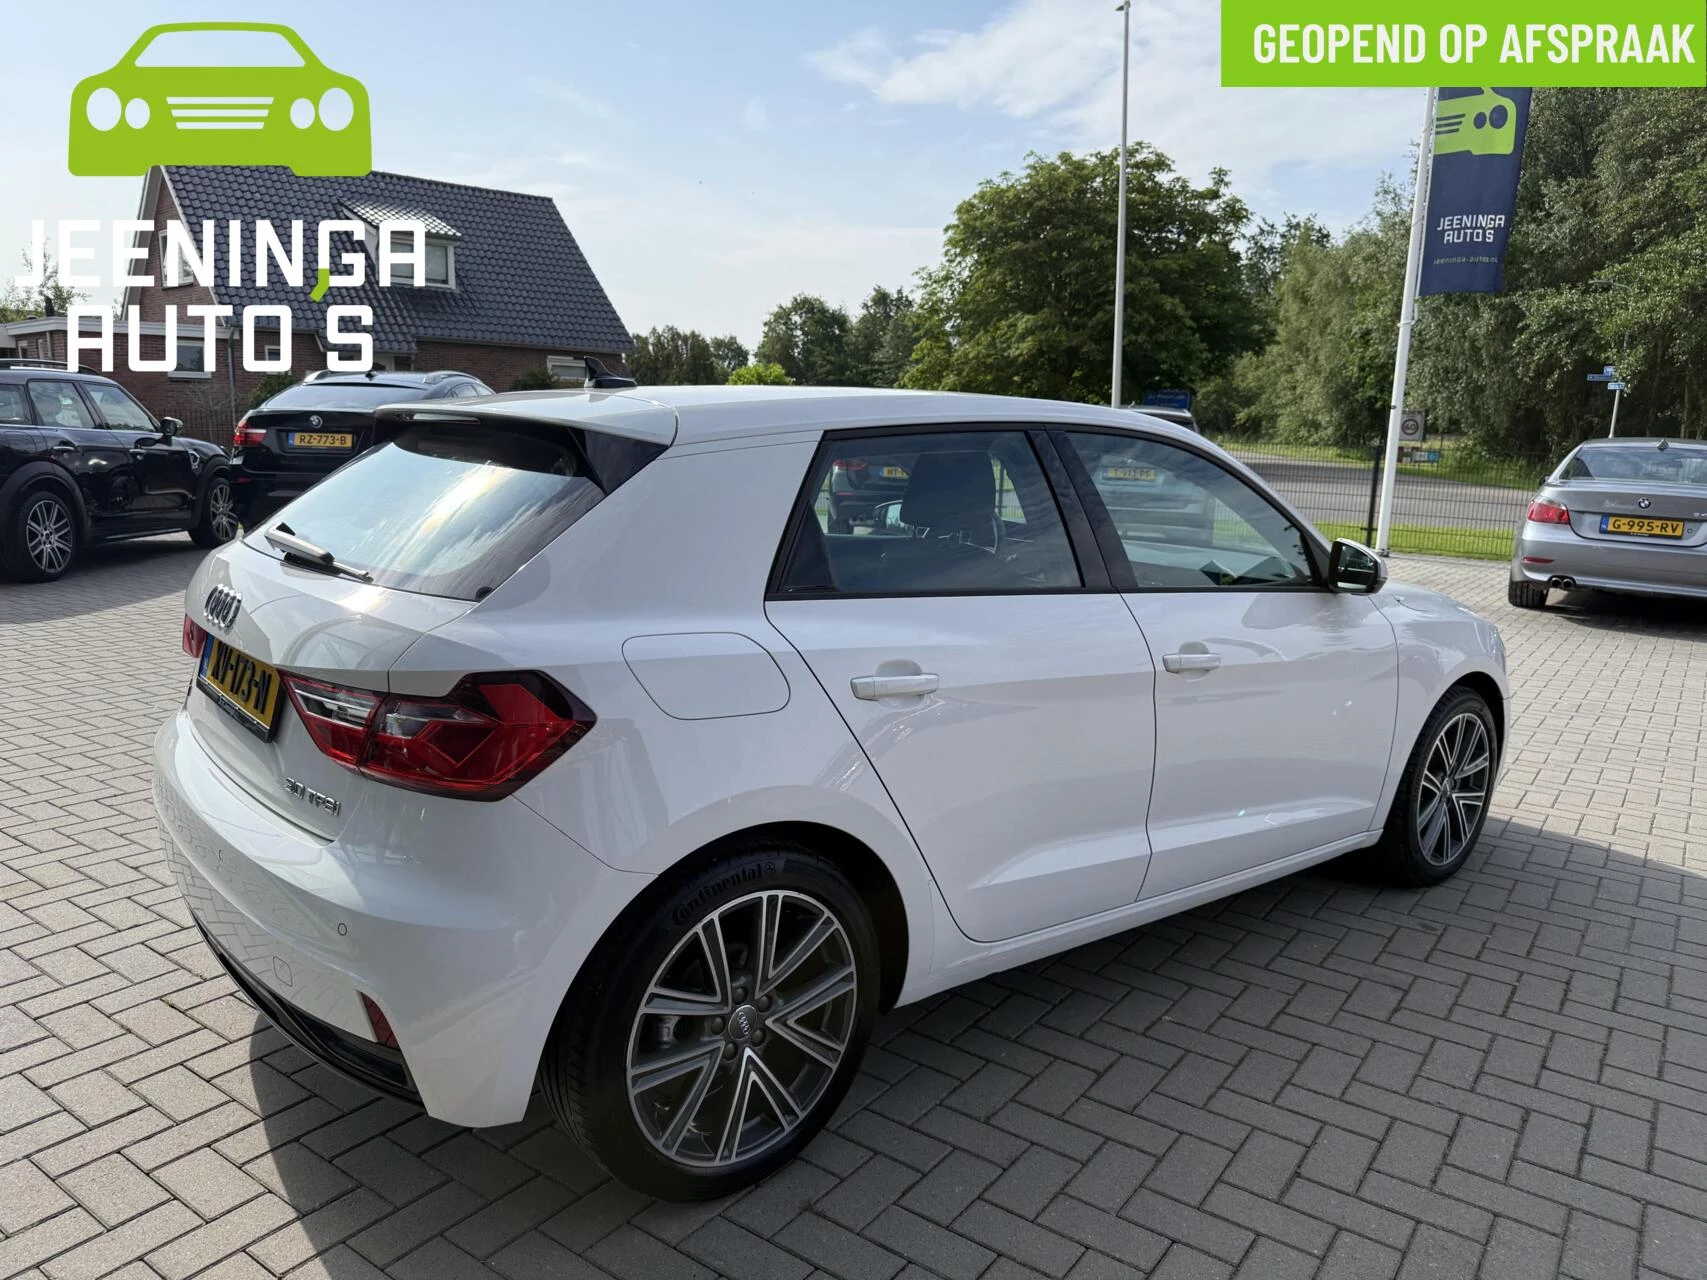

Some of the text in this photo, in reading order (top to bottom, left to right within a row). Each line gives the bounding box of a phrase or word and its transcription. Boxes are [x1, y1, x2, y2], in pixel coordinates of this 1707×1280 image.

[1436, 214, 1506, 231] JEENINGA
[299, 434, 347, 445] RZ-773-B
[1612, 519, 1679, 534] G-995-RV
[671, 862, 763, 926] Continental
